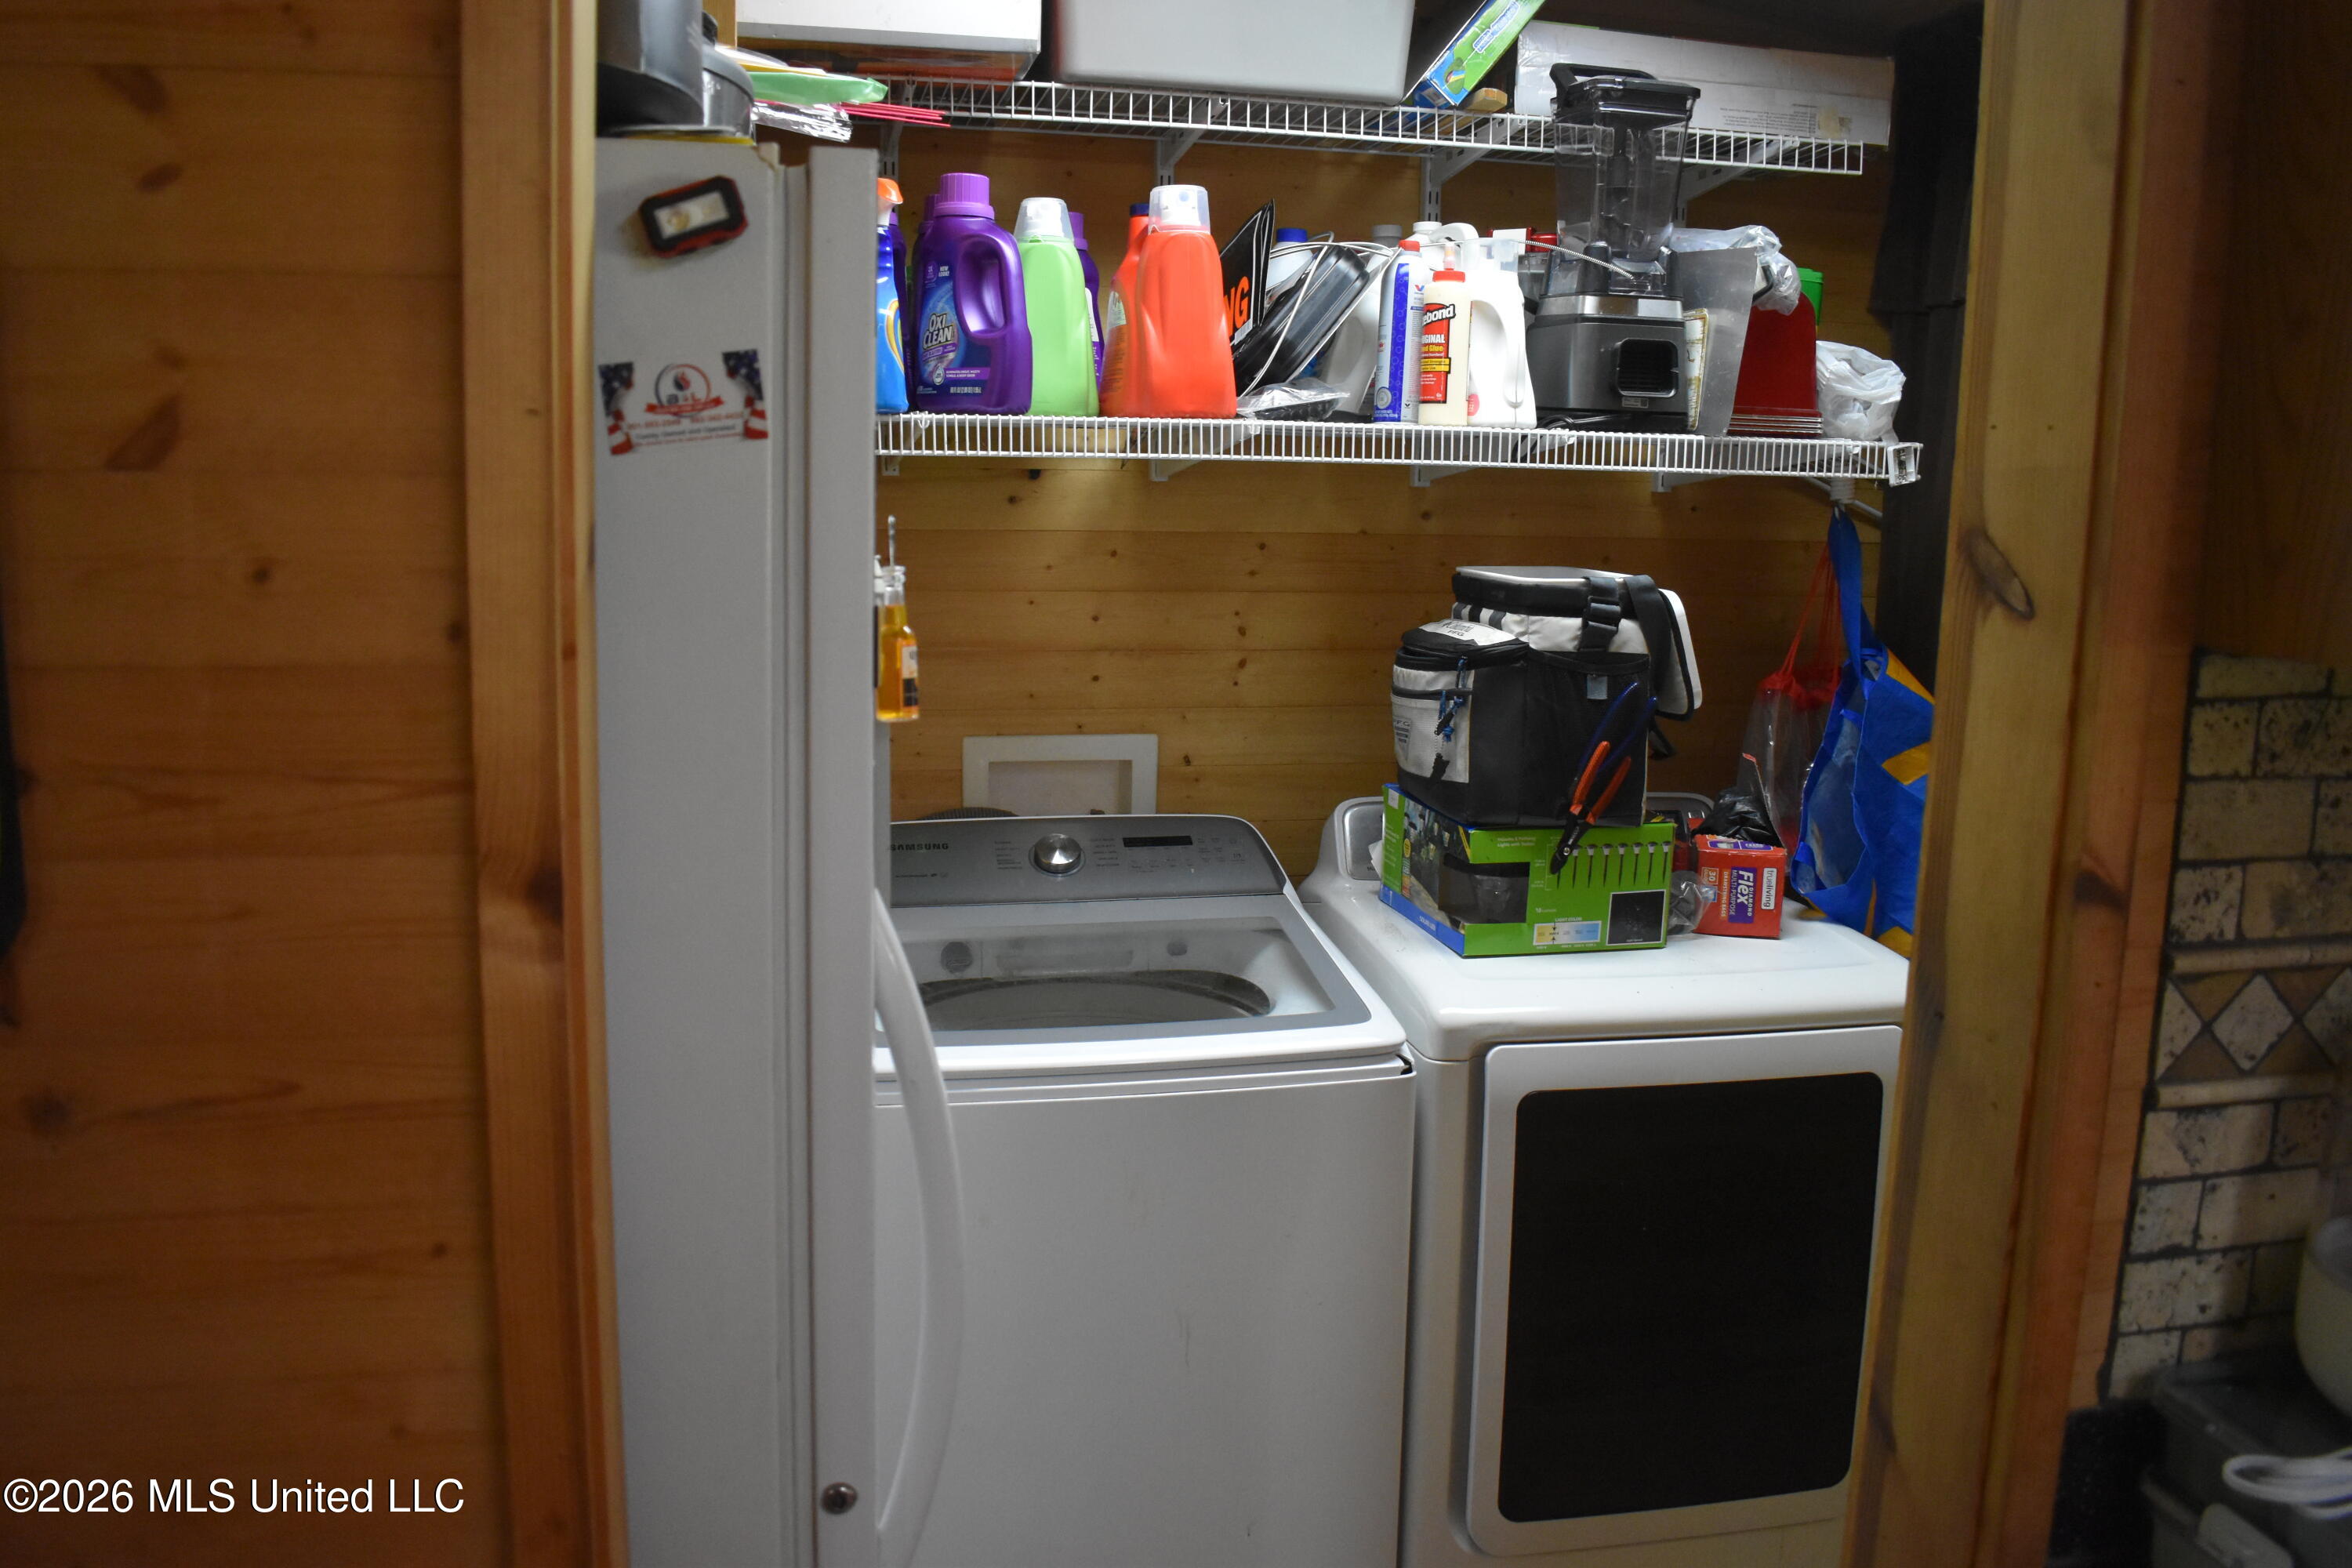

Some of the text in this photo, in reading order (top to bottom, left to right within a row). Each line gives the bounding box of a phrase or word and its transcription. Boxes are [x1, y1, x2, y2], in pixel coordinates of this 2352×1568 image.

[1224, 276, 1250, 336] NG
[1423, 304, 1455, 325] ebond
[930, 314, 947, 332] OXI
[923, 325, 953, 350] CLEAN
[890, 843, 949, 851] SAMSUNG
[1708, 871, 1717, 881] 30
[1737, 870, 1754, 906] Flex
[1729, 869, 1737, 916] MULTI-PURPOSE
[1762, 870, 1775, 908] trueliving
